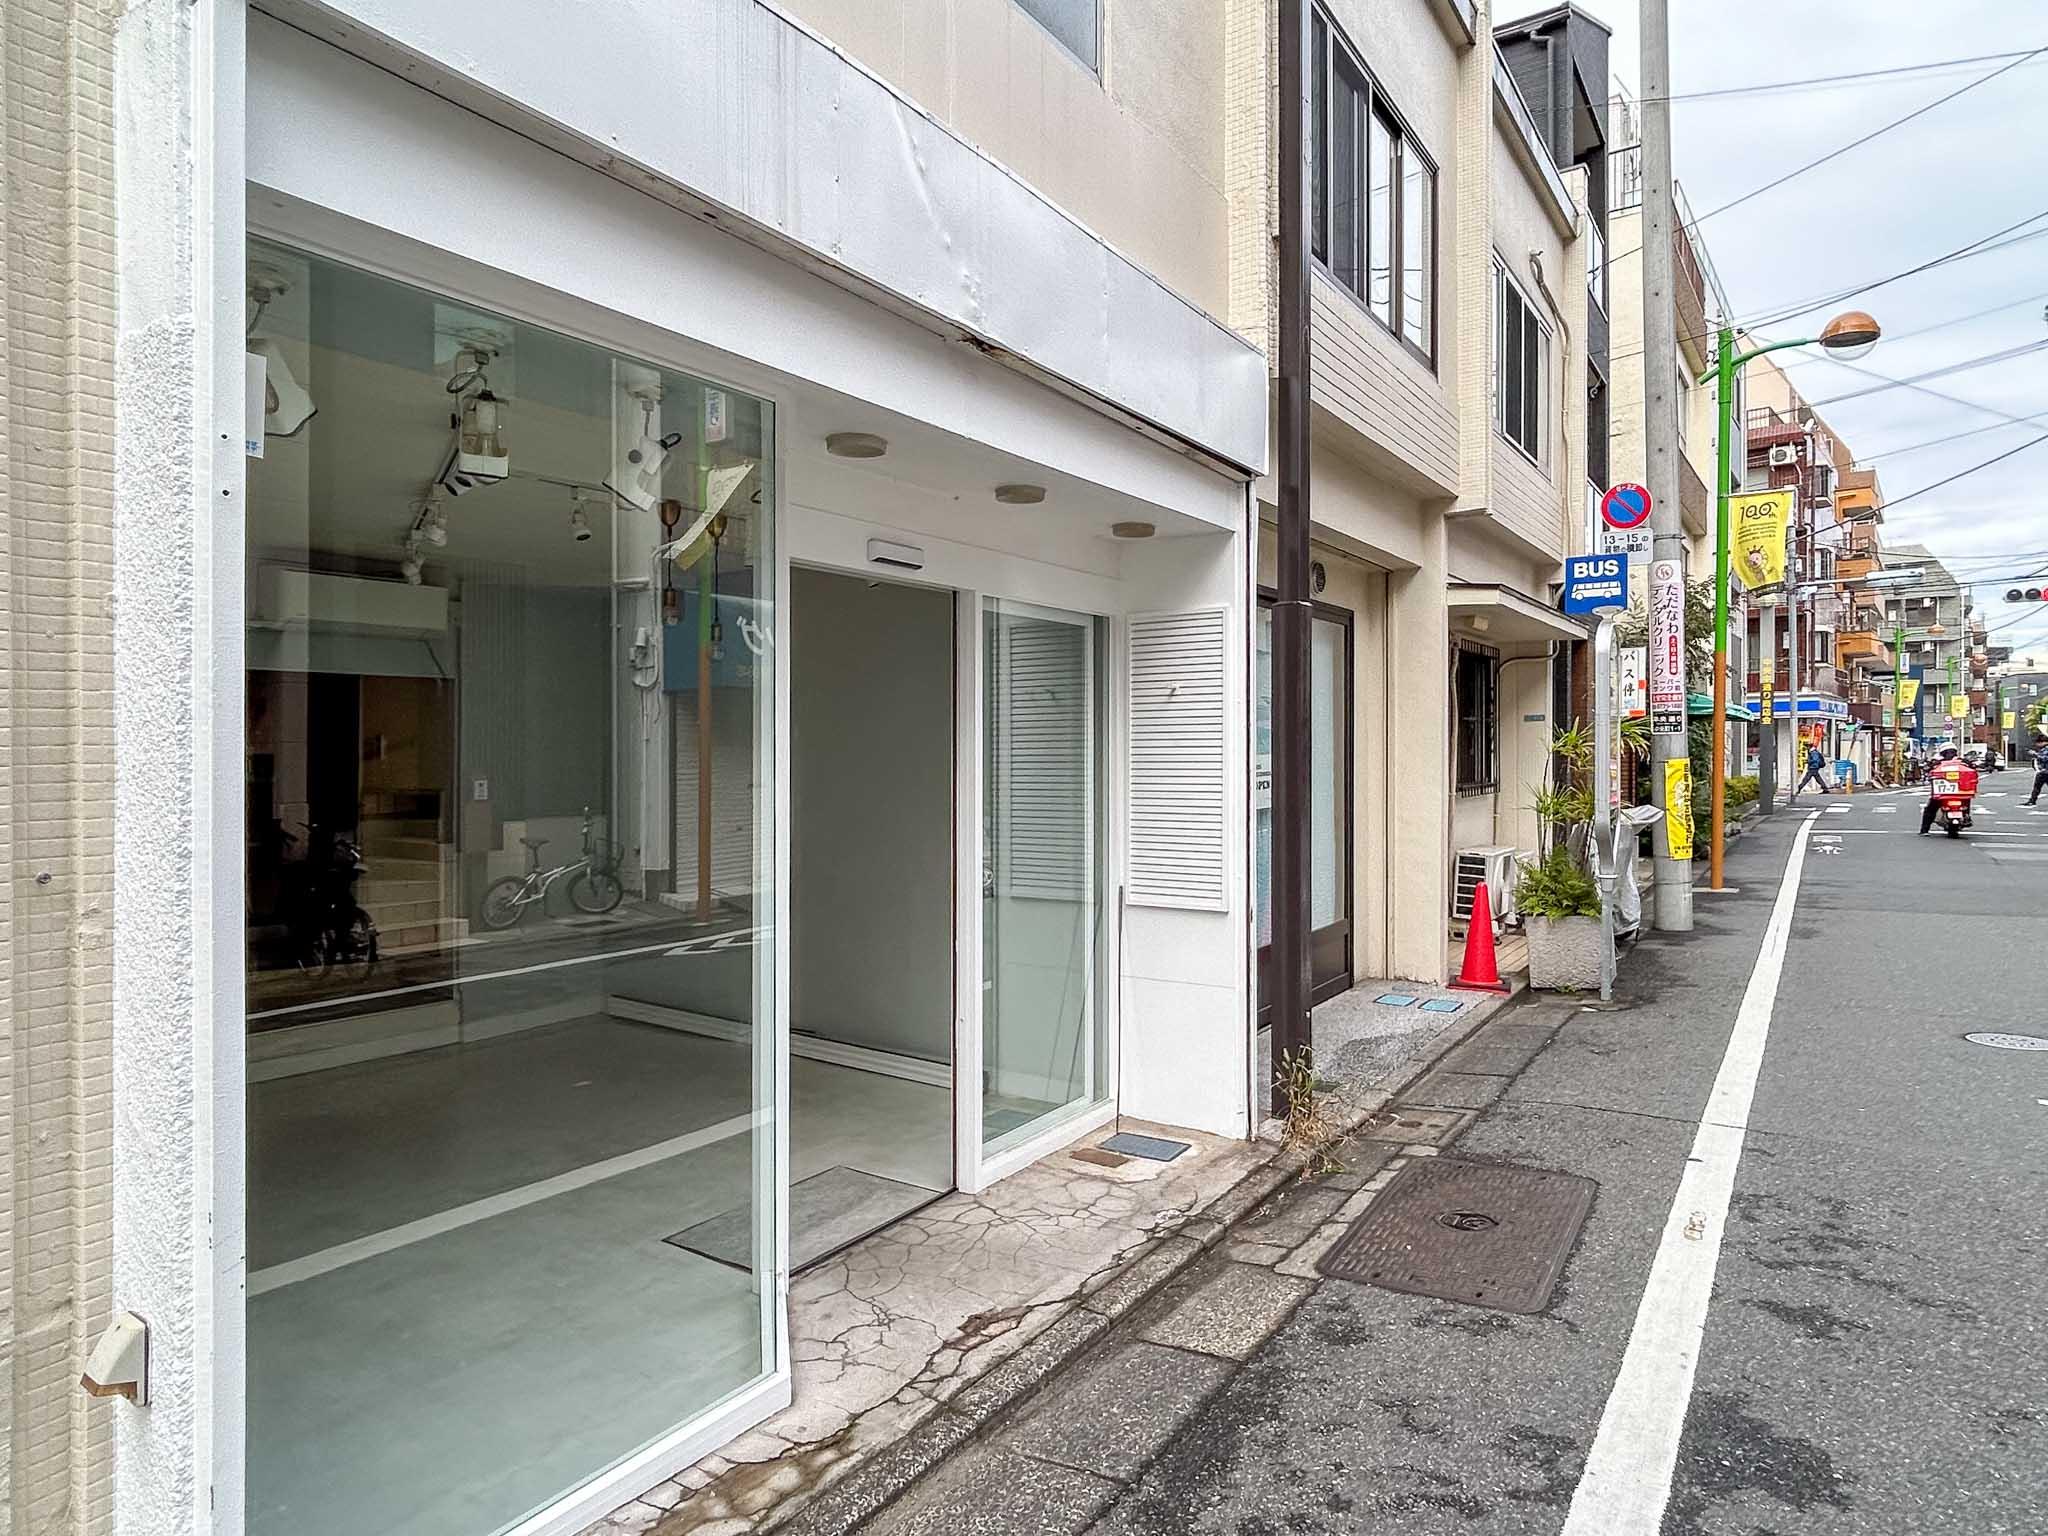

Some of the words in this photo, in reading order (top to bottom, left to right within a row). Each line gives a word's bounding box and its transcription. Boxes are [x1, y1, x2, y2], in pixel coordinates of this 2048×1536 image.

[1573, 559, 1620, 579] BUS
[1652, 584, 1668, 678] デンタルクリニック
[1665, 583, 1680, 635] ただなわ
[1623, 651, 1636, 697] バス停
